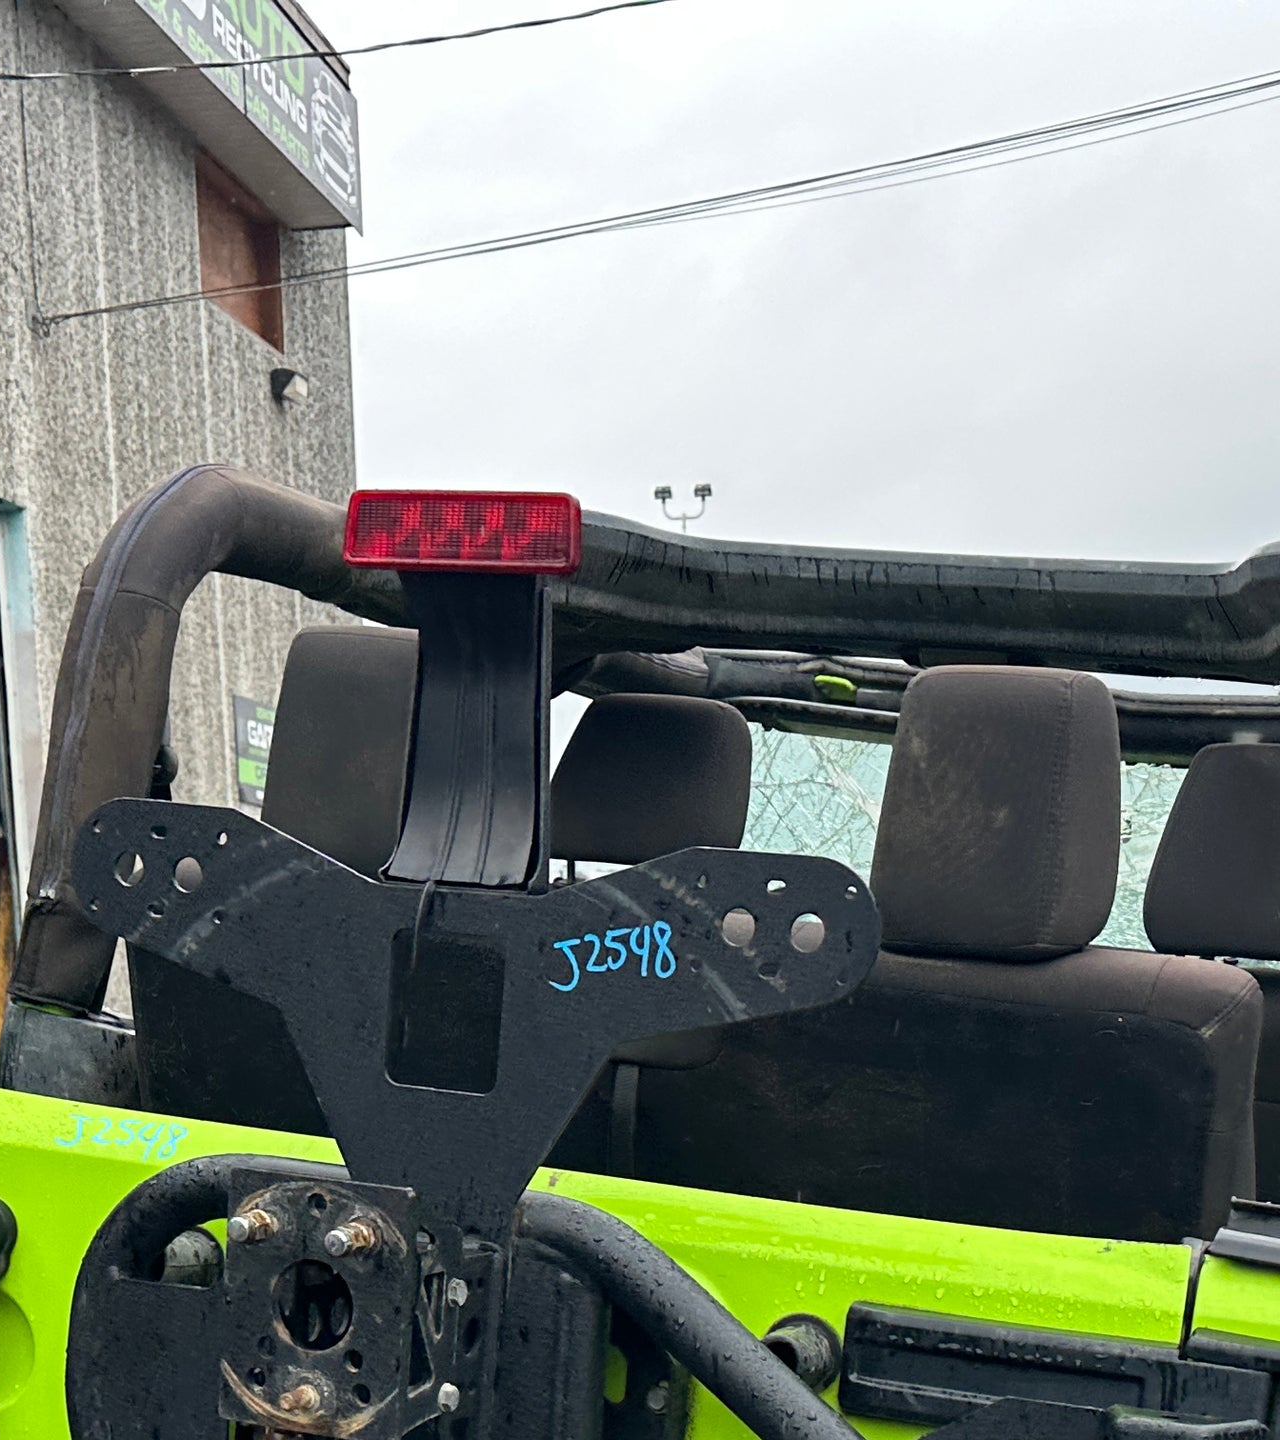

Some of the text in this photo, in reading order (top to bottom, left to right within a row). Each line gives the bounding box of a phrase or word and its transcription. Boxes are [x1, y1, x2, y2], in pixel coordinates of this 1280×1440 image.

[212, 4, 308, 133] RECYCLING
[549, 920, 676, 992] J2548
[55, 1113, 188, 1162] J2548
